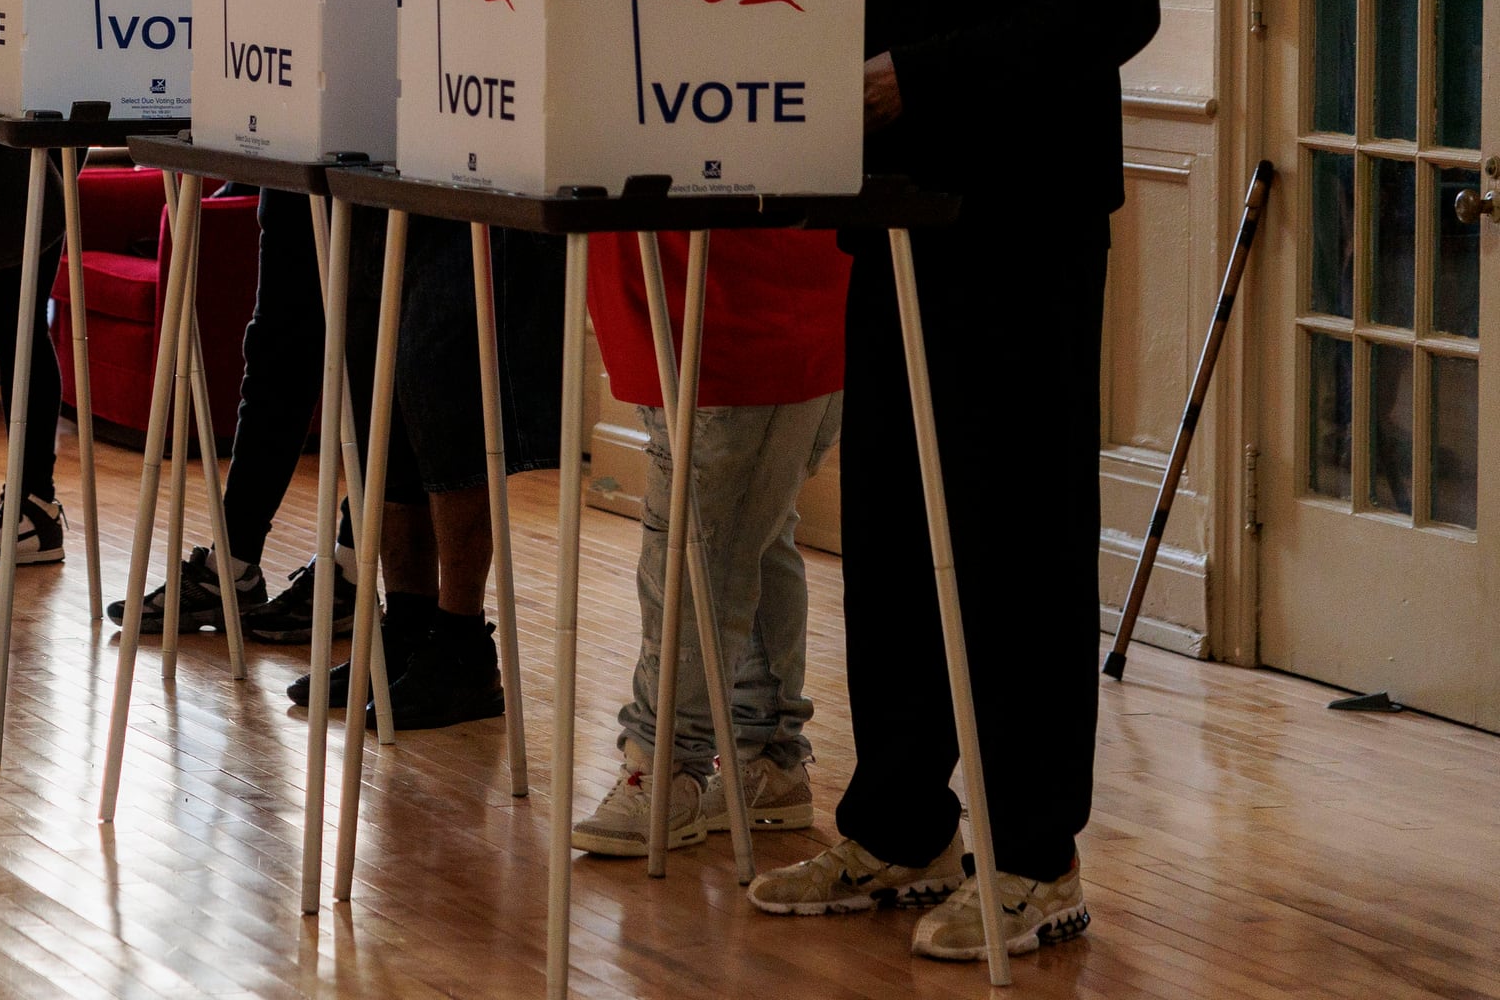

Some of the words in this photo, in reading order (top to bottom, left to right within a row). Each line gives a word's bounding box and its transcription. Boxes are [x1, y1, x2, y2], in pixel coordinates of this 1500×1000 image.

[108, 15, 192, 50] VOT
[230, 41, 293, 88] VOTE
[445, 73, 516, 122] VOTE
[651, 81, 806, 124] VOTE
[709, 184, 732, 193] Voting
[734, 184, 756, 192] Booth
